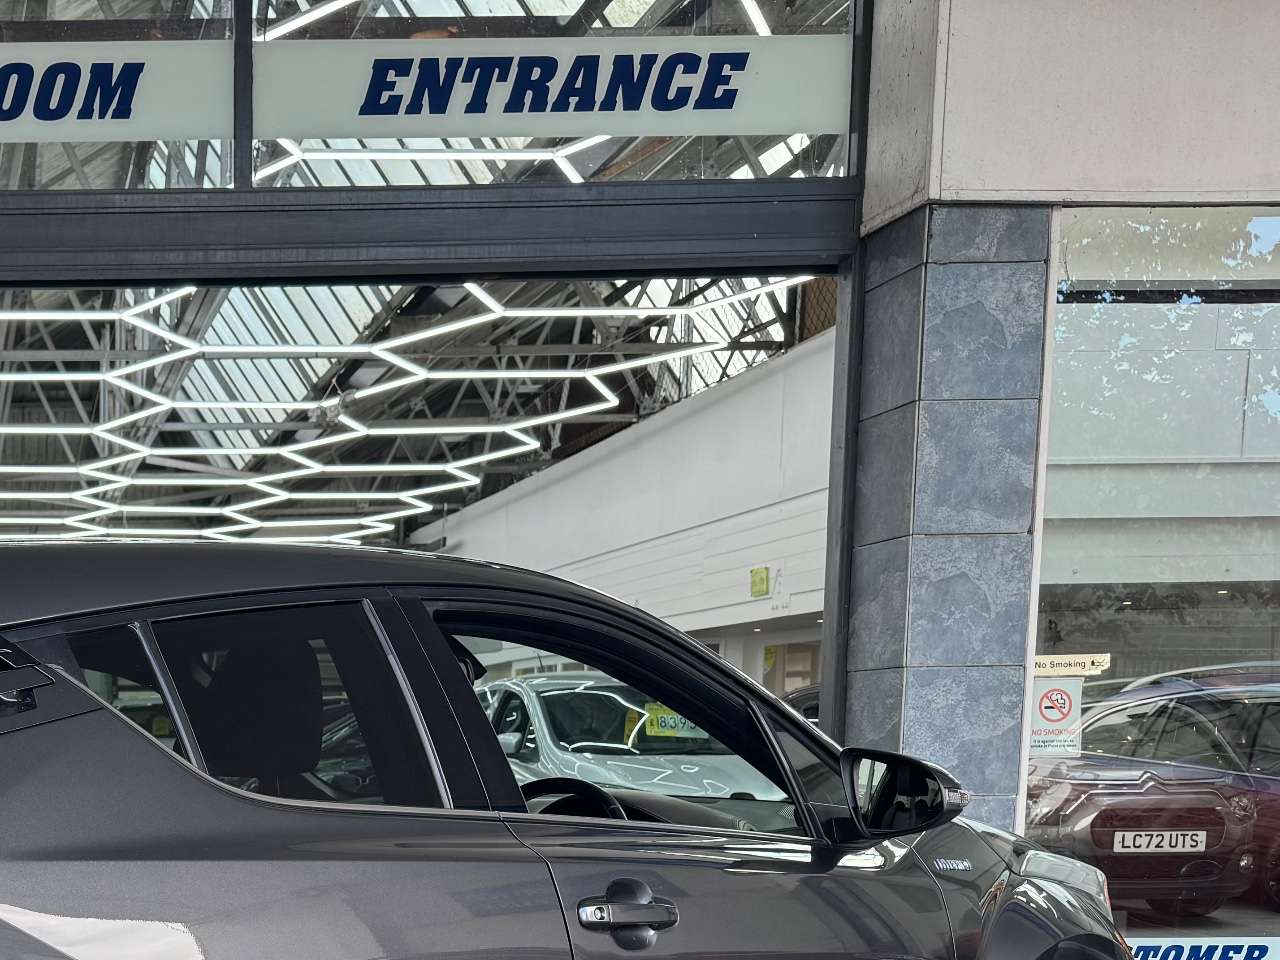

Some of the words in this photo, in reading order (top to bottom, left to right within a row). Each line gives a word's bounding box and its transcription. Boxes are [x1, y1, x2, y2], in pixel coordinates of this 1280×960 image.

[357, 51, 751, 116] ENTRANCE
[1034, 661, 1047, 669] No
[1049, 660, 1086, 670] Smoking
[1121, 833, 1165, 849] LC72
[1168, 833, 1199, 849] UTS
